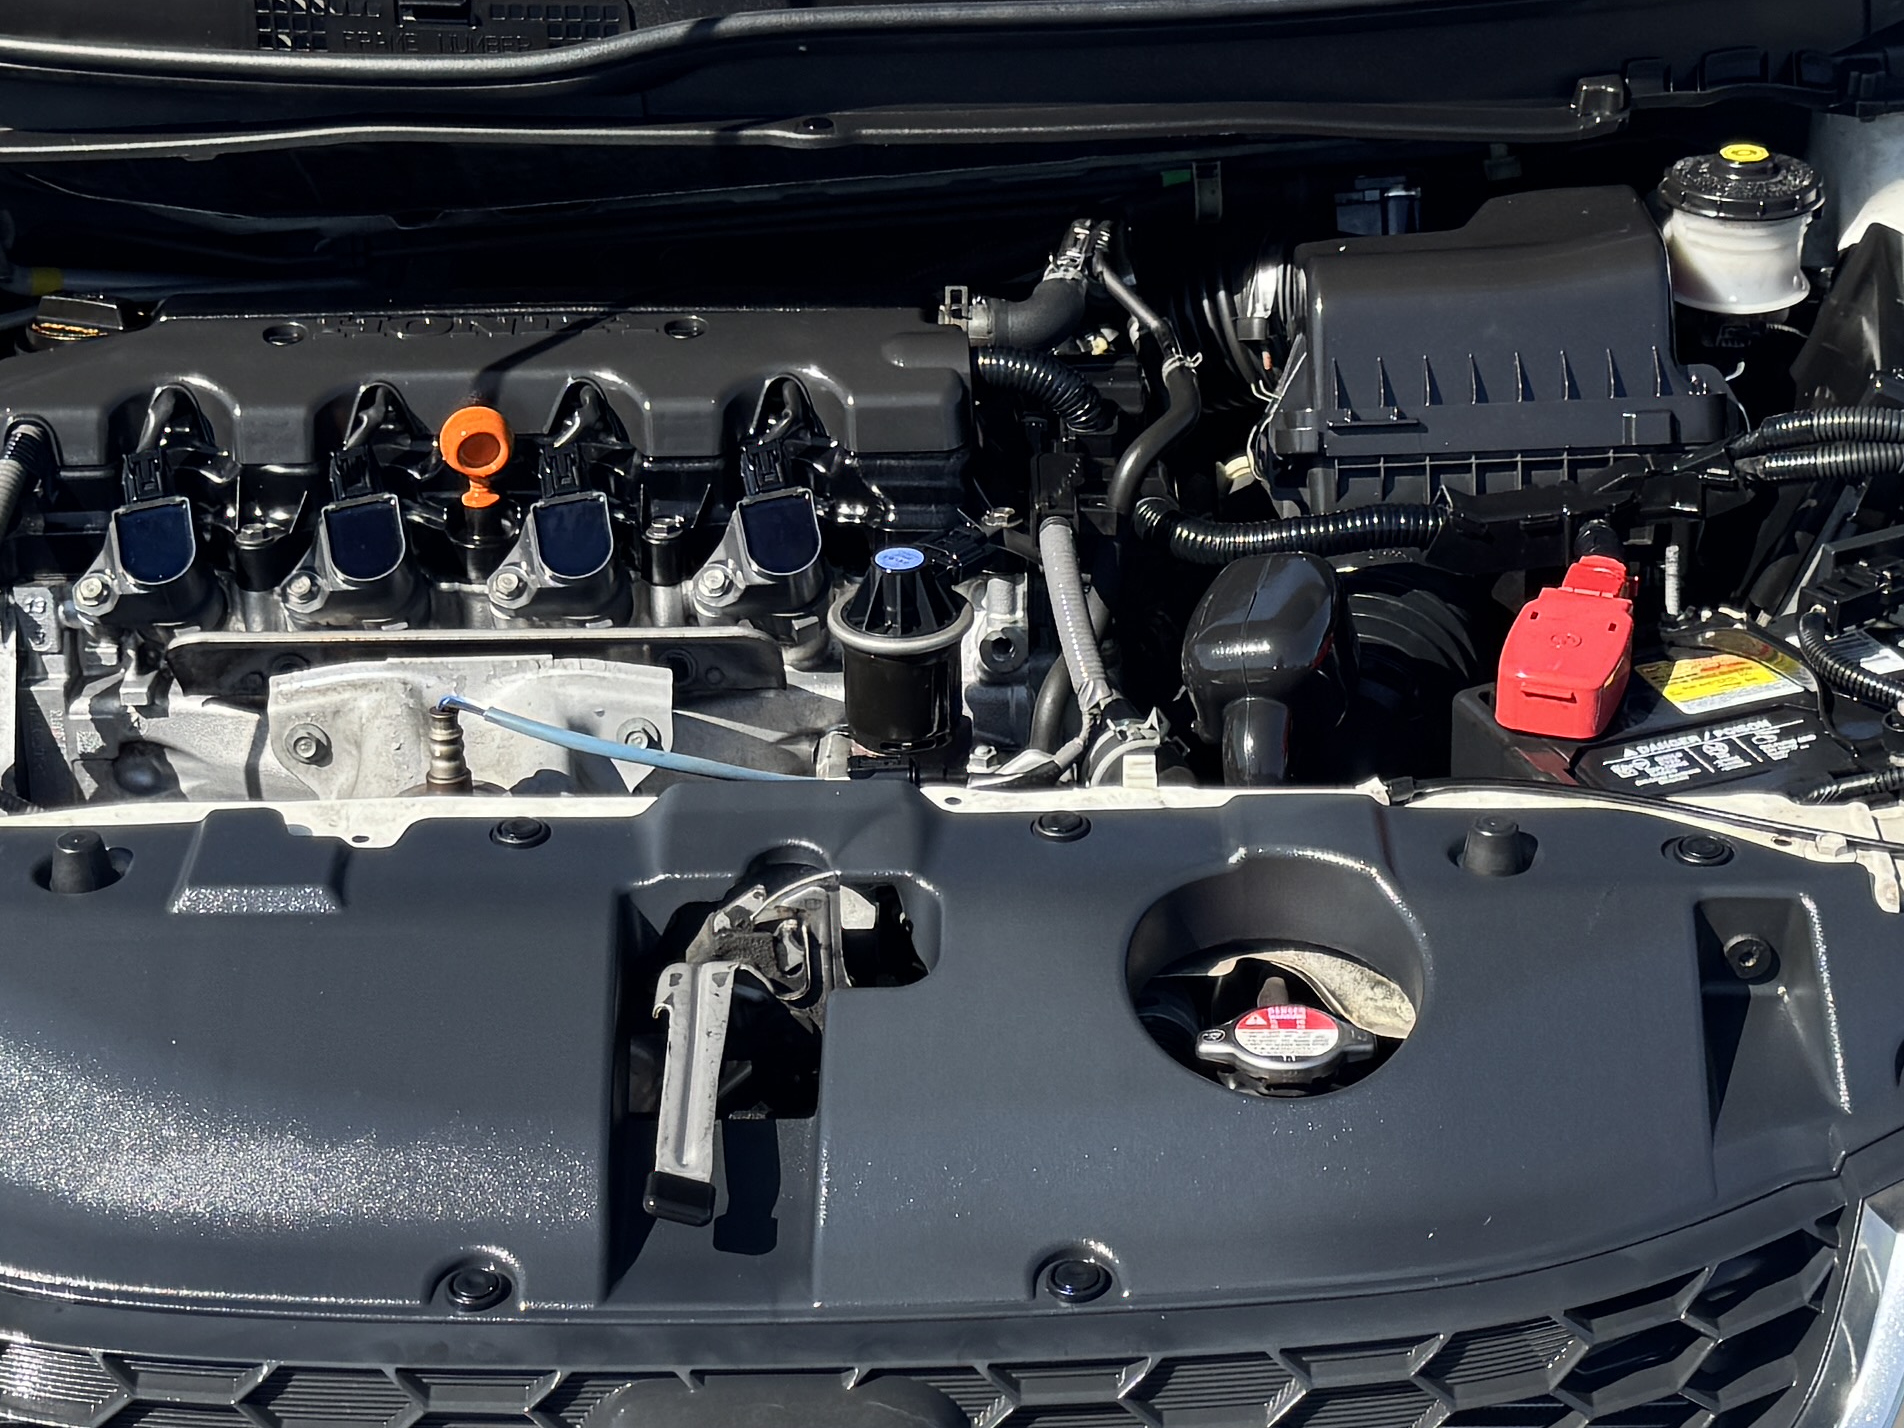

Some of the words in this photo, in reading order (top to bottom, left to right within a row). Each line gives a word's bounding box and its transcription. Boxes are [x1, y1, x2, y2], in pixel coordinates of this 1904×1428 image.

[343, 30, 418, 53] FRAME
[437, 31, 531, 53] NUMBER
[1636, 735, 1699, 753] DANGER
